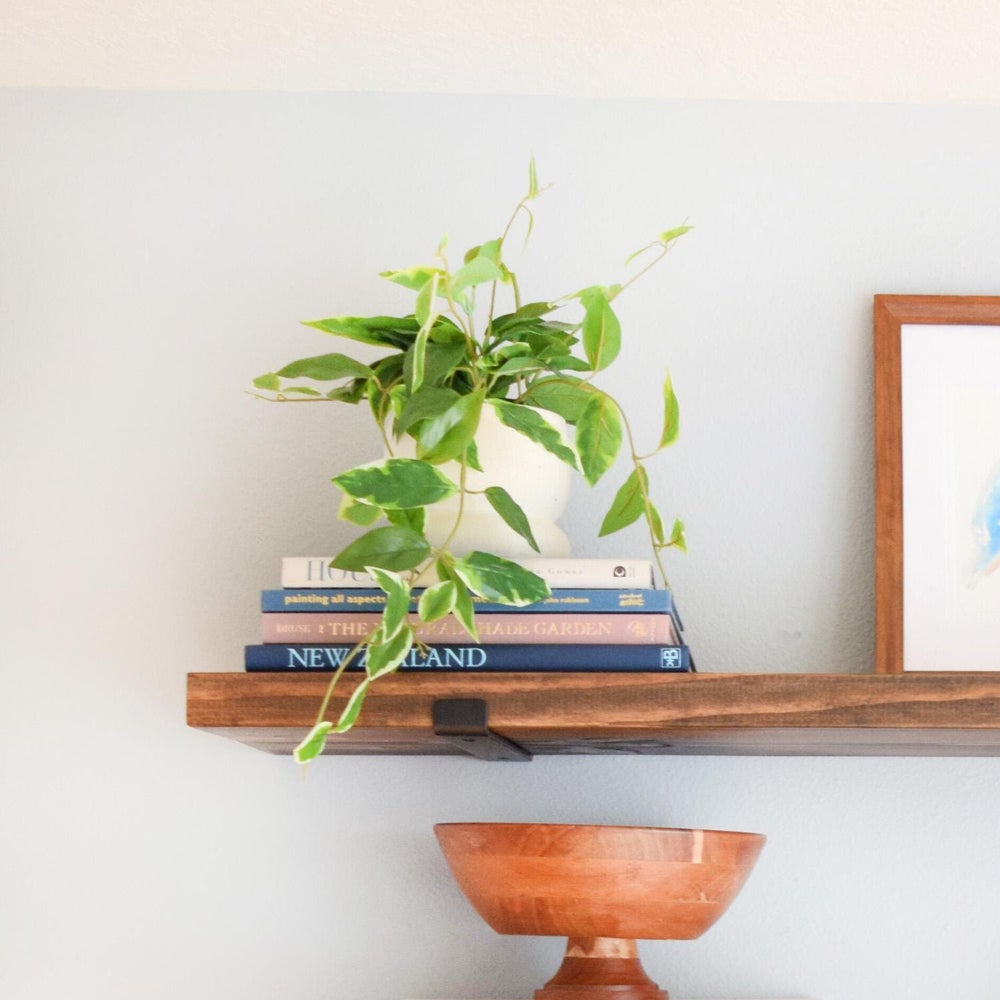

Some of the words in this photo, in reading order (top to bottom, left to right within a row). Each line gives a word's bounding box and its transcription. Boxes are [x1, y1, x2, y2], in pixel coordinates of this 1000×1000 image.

[284, 593, 329, 606] painting
[331, 594, 345, 604] all
[346, 595, 387, 606] aspects
[328, 622, 369, 636] THE
[478, 622, 530, 636] HADE
[533, 622, 613, 636] GARDEN
[286, 648, 350, 668] NEW
[357, 648, 487, 668] ZLAND
